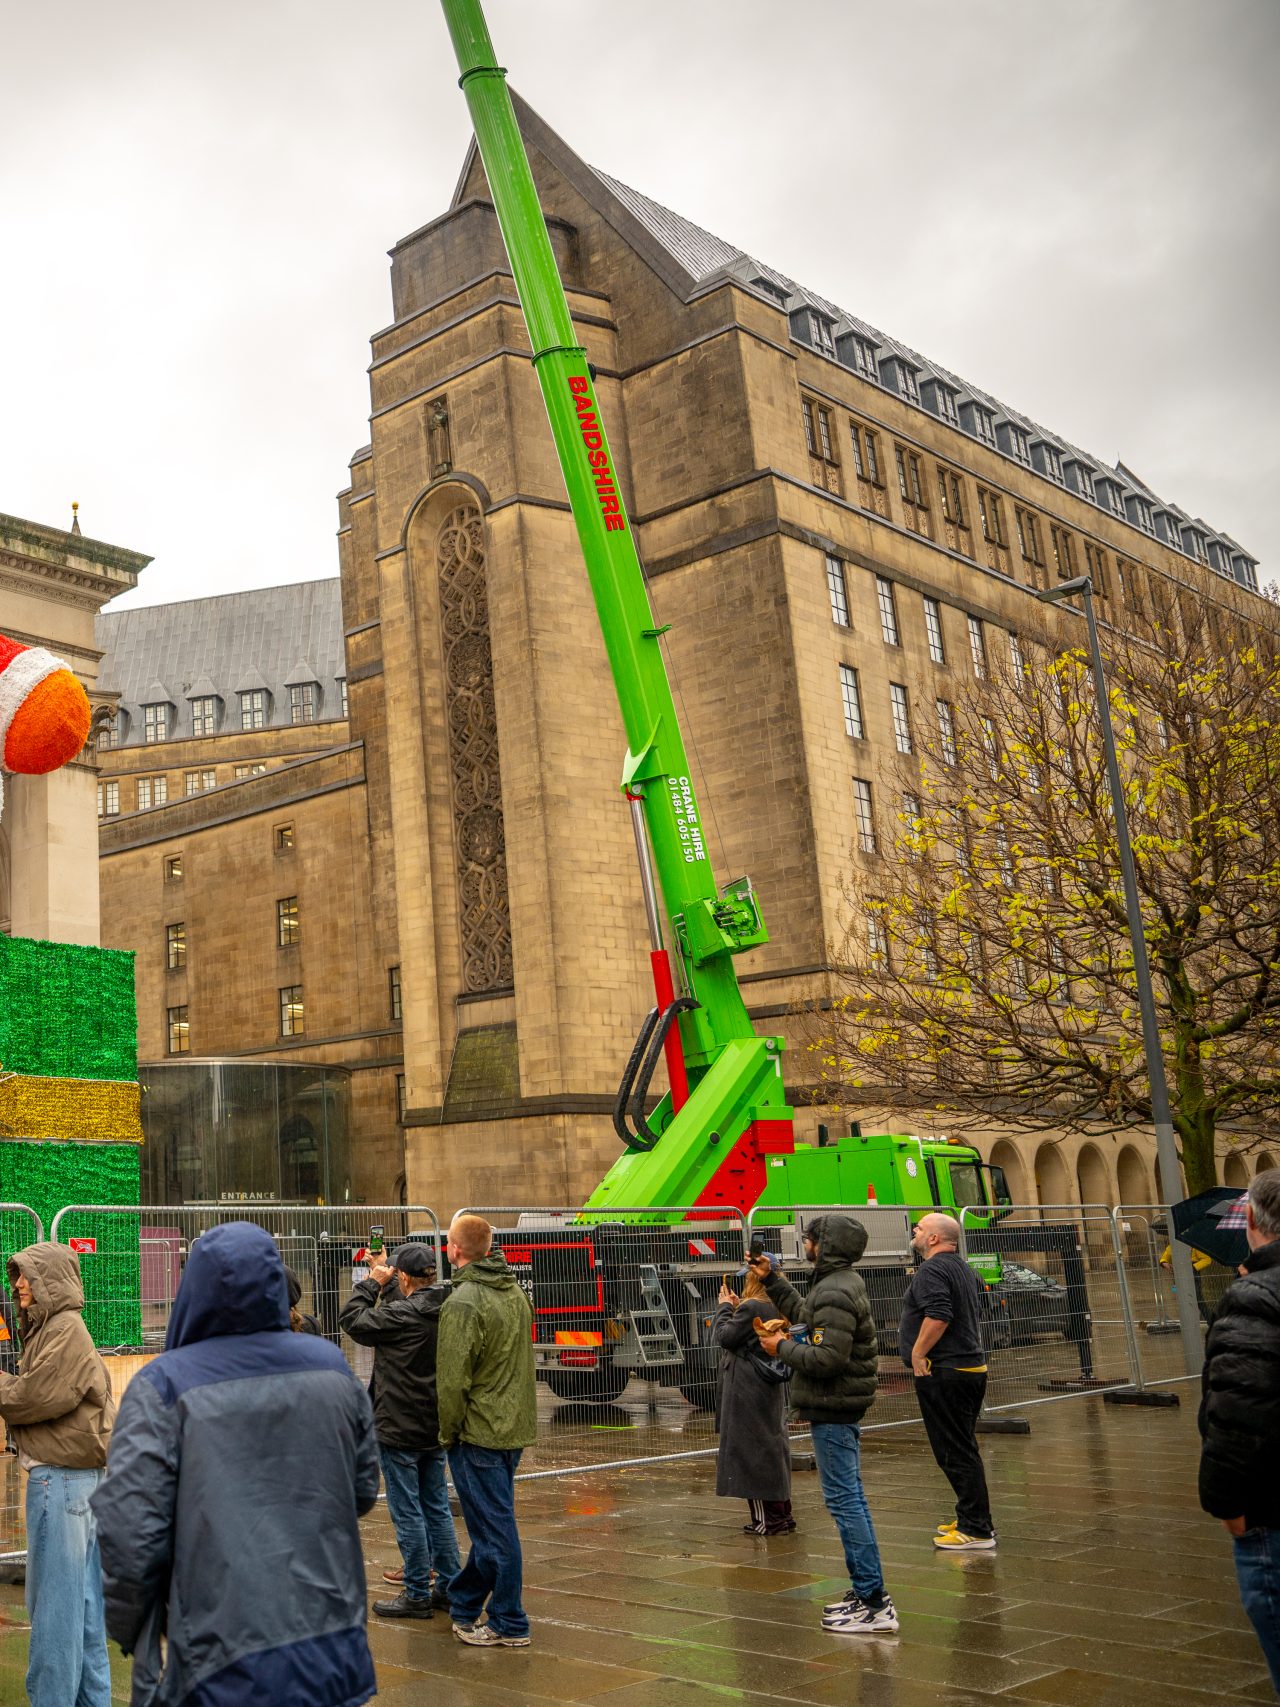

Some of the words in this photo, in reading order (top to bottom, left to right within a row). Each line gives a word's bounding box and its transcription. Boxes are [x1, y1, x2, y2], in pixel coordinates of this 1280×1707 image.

[568, 376, 624, 531] BANDSHIRE
[668, 778, 684, 814] 01484
[677, 818, 695, 863] 605150
[679, 776, 697, 824] CRANE
[690, 827, 705, 861] HIRE
[221, 1192, 275, 1200] ENTRANCE
